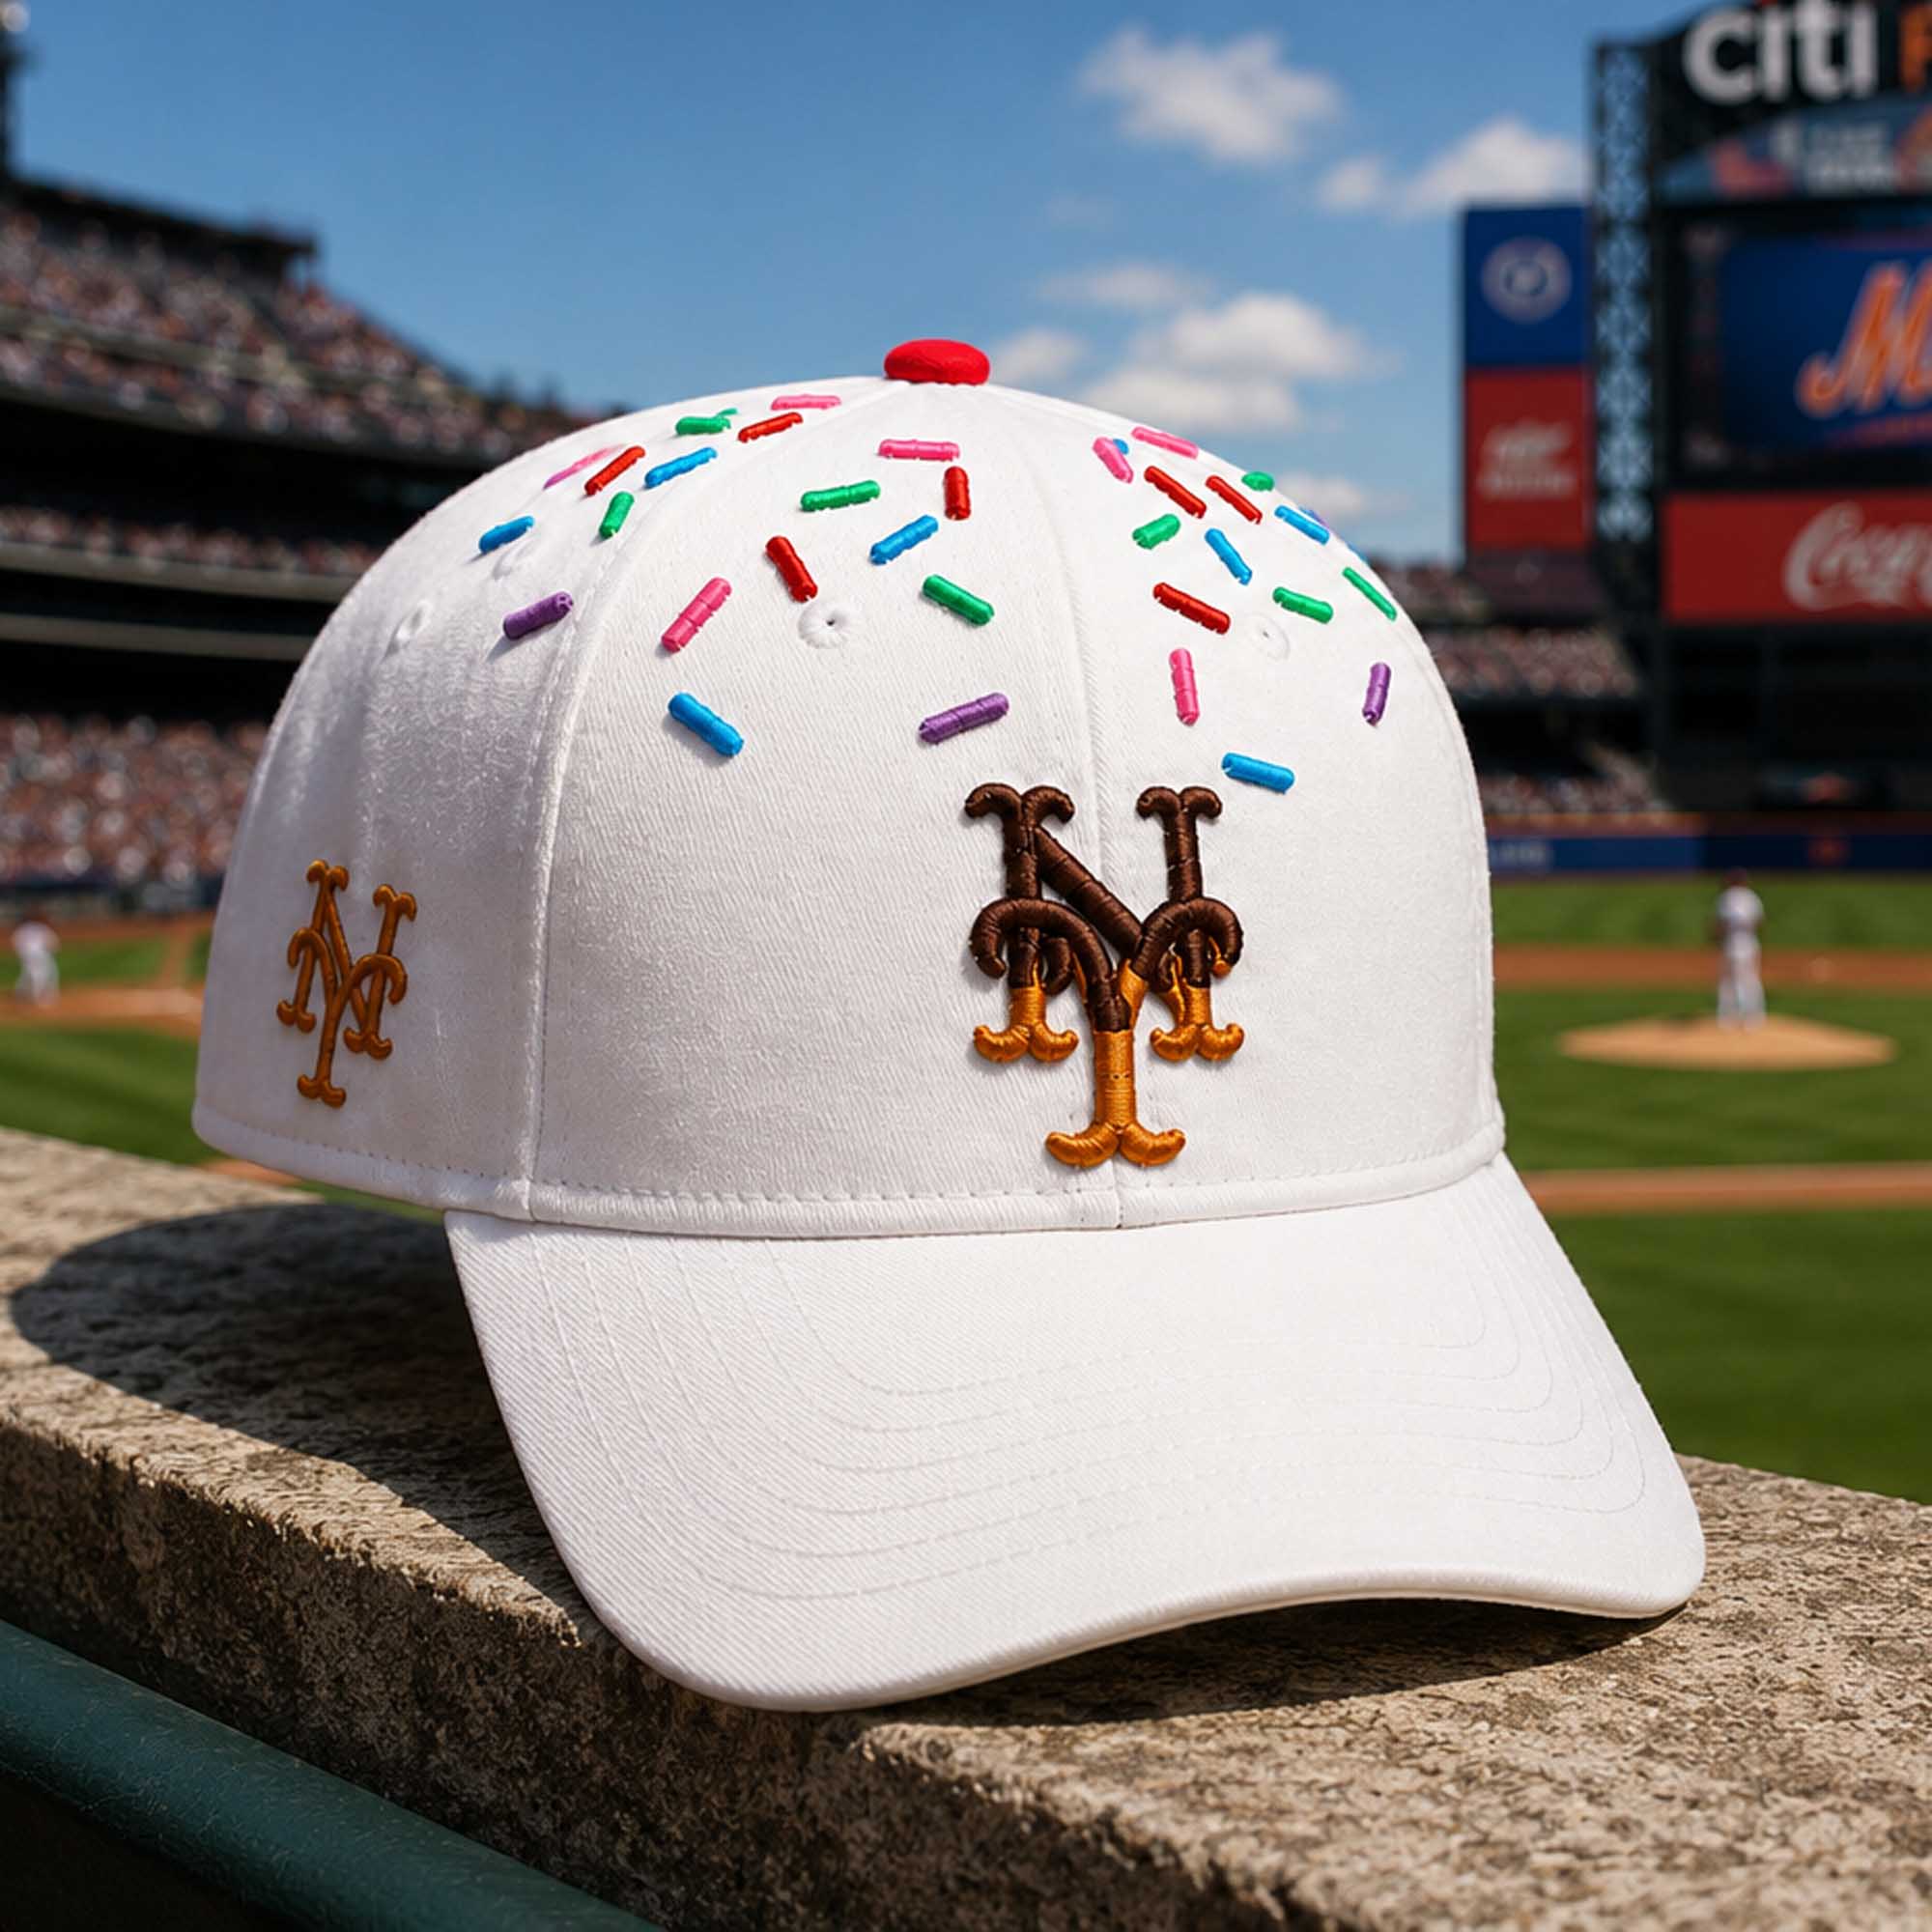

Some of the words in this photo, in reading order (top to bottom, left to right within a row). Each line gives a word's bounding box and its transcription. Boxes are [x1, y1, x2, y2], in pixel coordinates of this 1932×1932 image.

[1683, 0, 1877, 103] citi
[276, 859, 417, 1108] NY
[964, 782, 1244, 1167] NY
